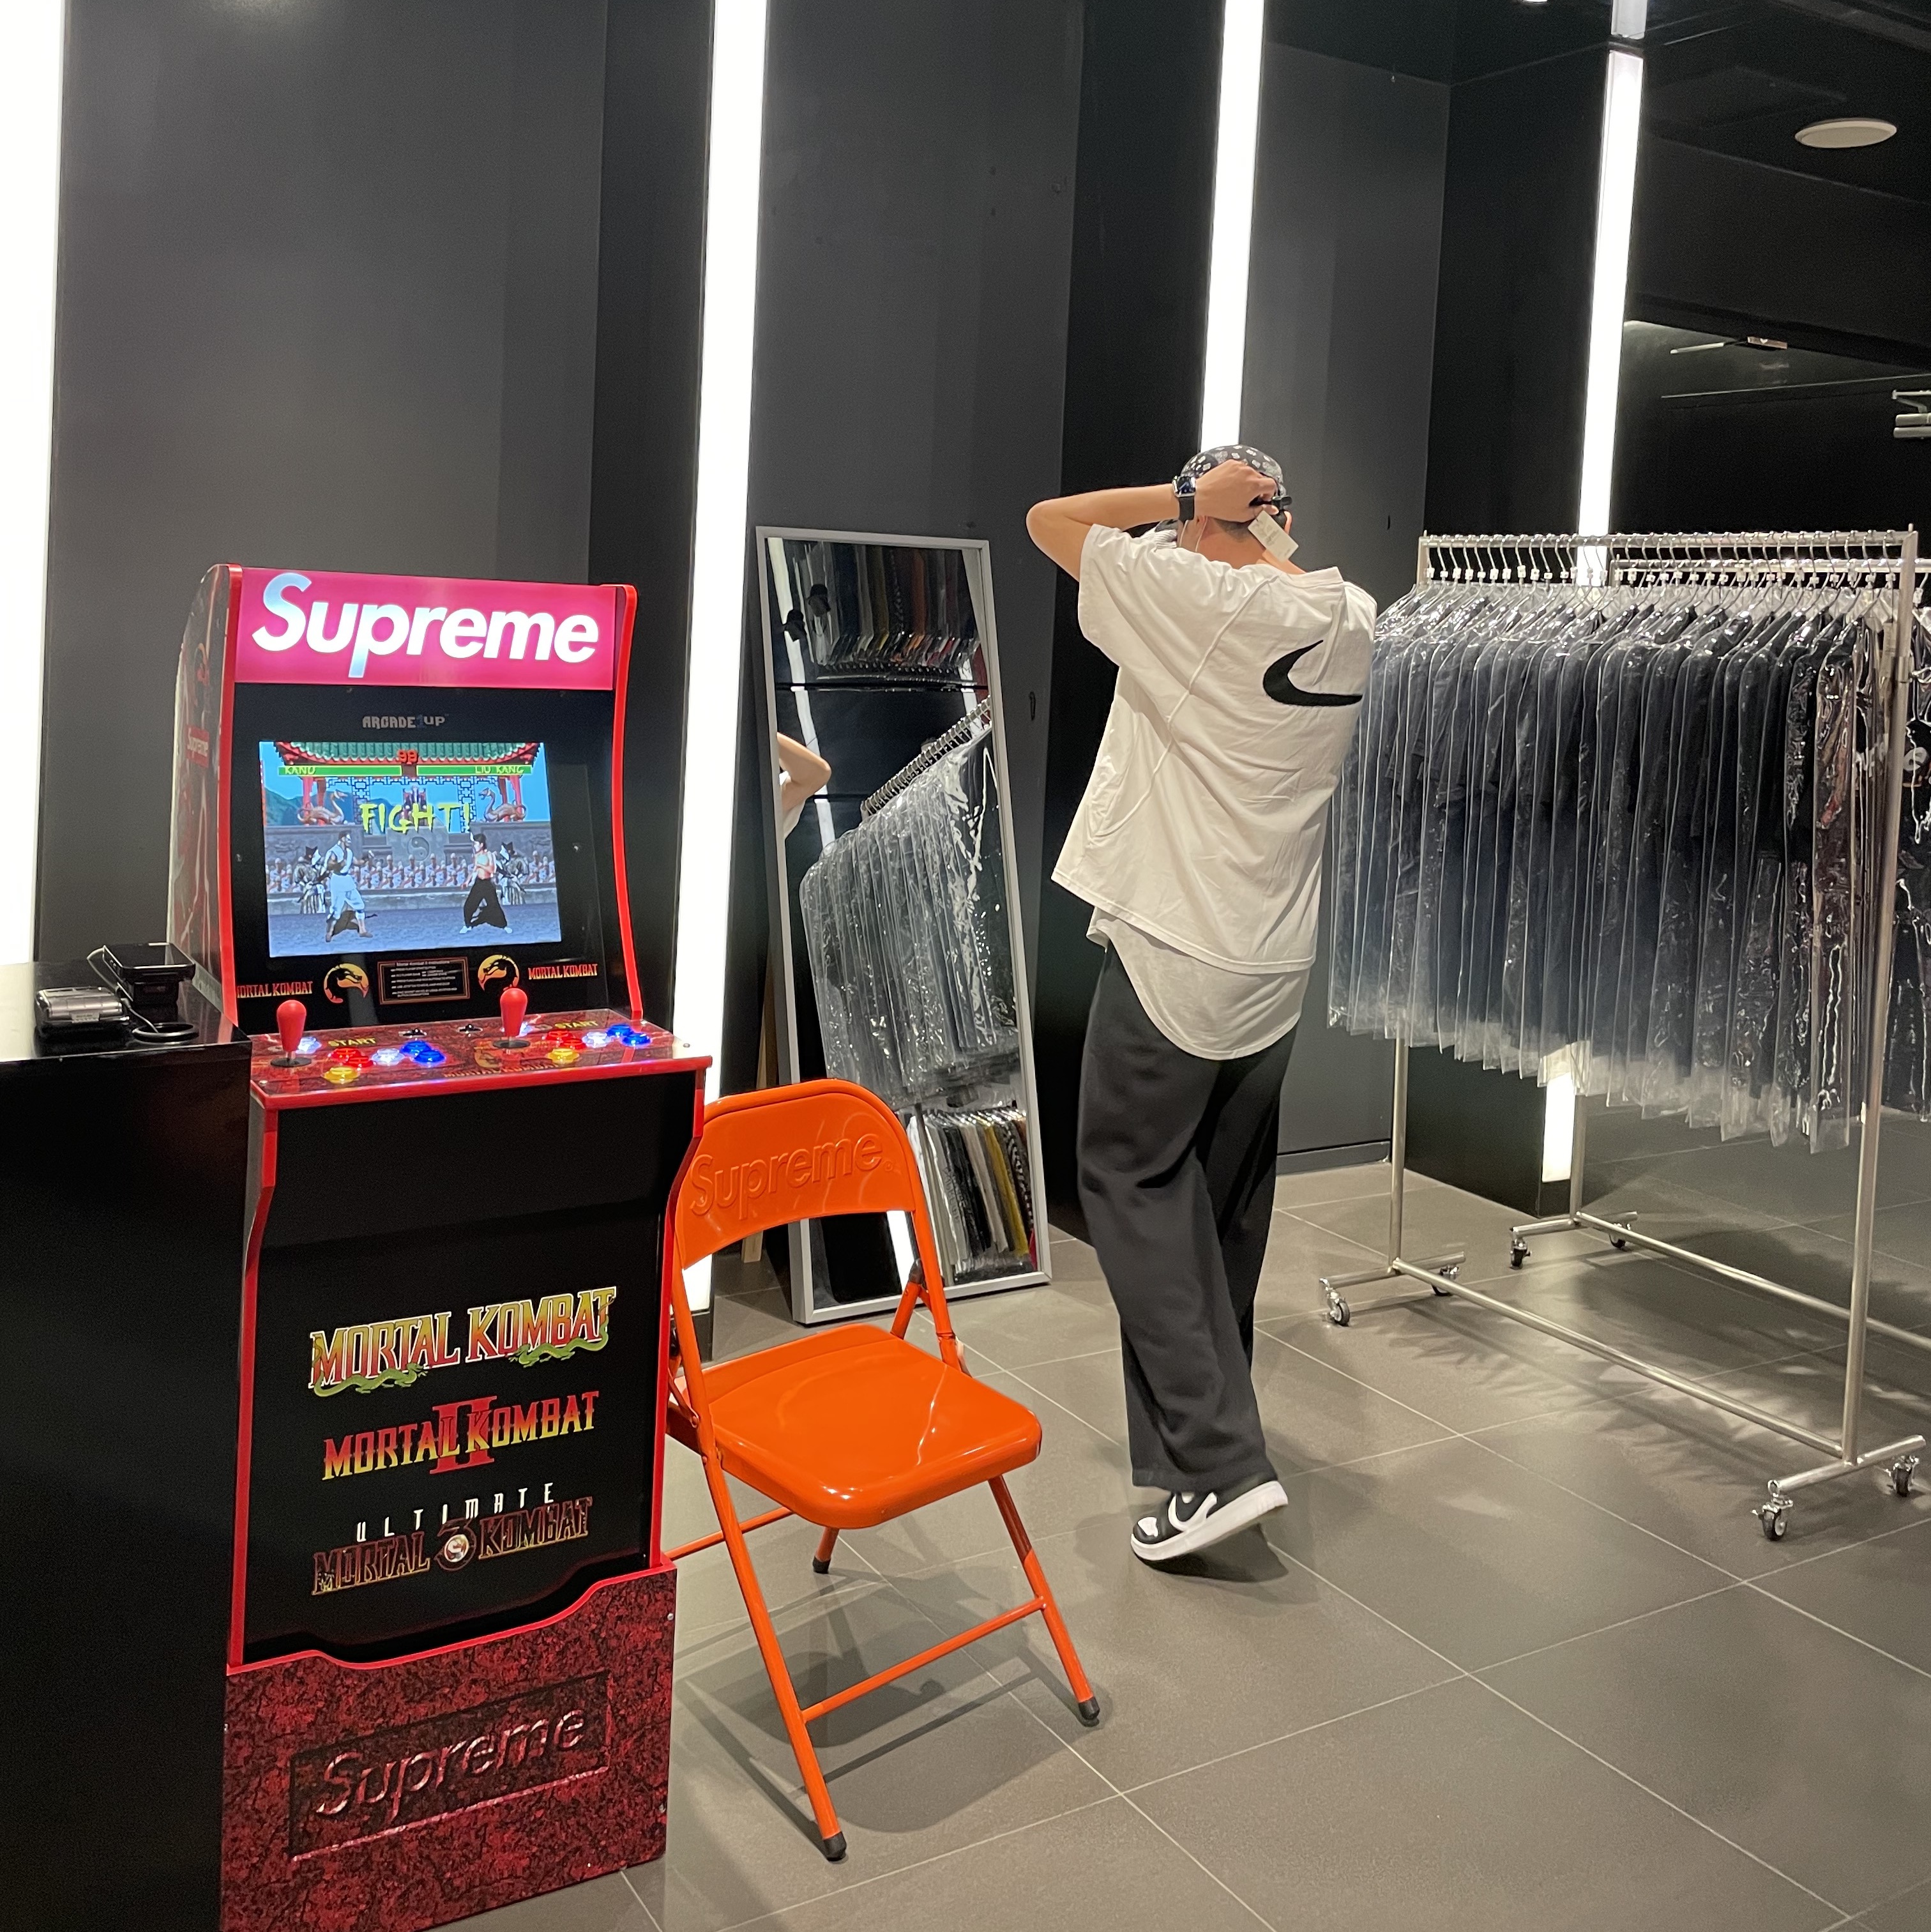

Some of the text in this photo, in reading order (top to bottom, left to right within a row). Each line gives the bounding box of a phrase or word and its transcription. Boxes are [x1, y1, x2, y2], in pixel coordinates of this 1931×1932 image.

[252, 572, 599, 678] Supreme
[285, 766, 315, 775] KANO
[397, 749, 418, 763] 99
[474, 766, 524, 774] LIU KANG
[360, 803, 471, 833] FIGHT!
[527, 963, 598, 980] MORTAL KOMBAT
[272, 981, 313, 996] KOMBAT
[554, 1021, 598, 1029] START
[328, 1037, 377, 1047] START
[689, 1134, 882, 1221] Supreme
[308, 1286, 617, 1388] MORTAL KOMBAT
[322, 1415, 460, 1480] MORTAL
[466, 1390, 599, 1453] KOMBAT
[356, 1482, 554, 1542] ULTIMATE
[311, 1496, 593, 1595] MORTAL 3 KOMBAT
[315, 1708, 585, 1823] Supreme
